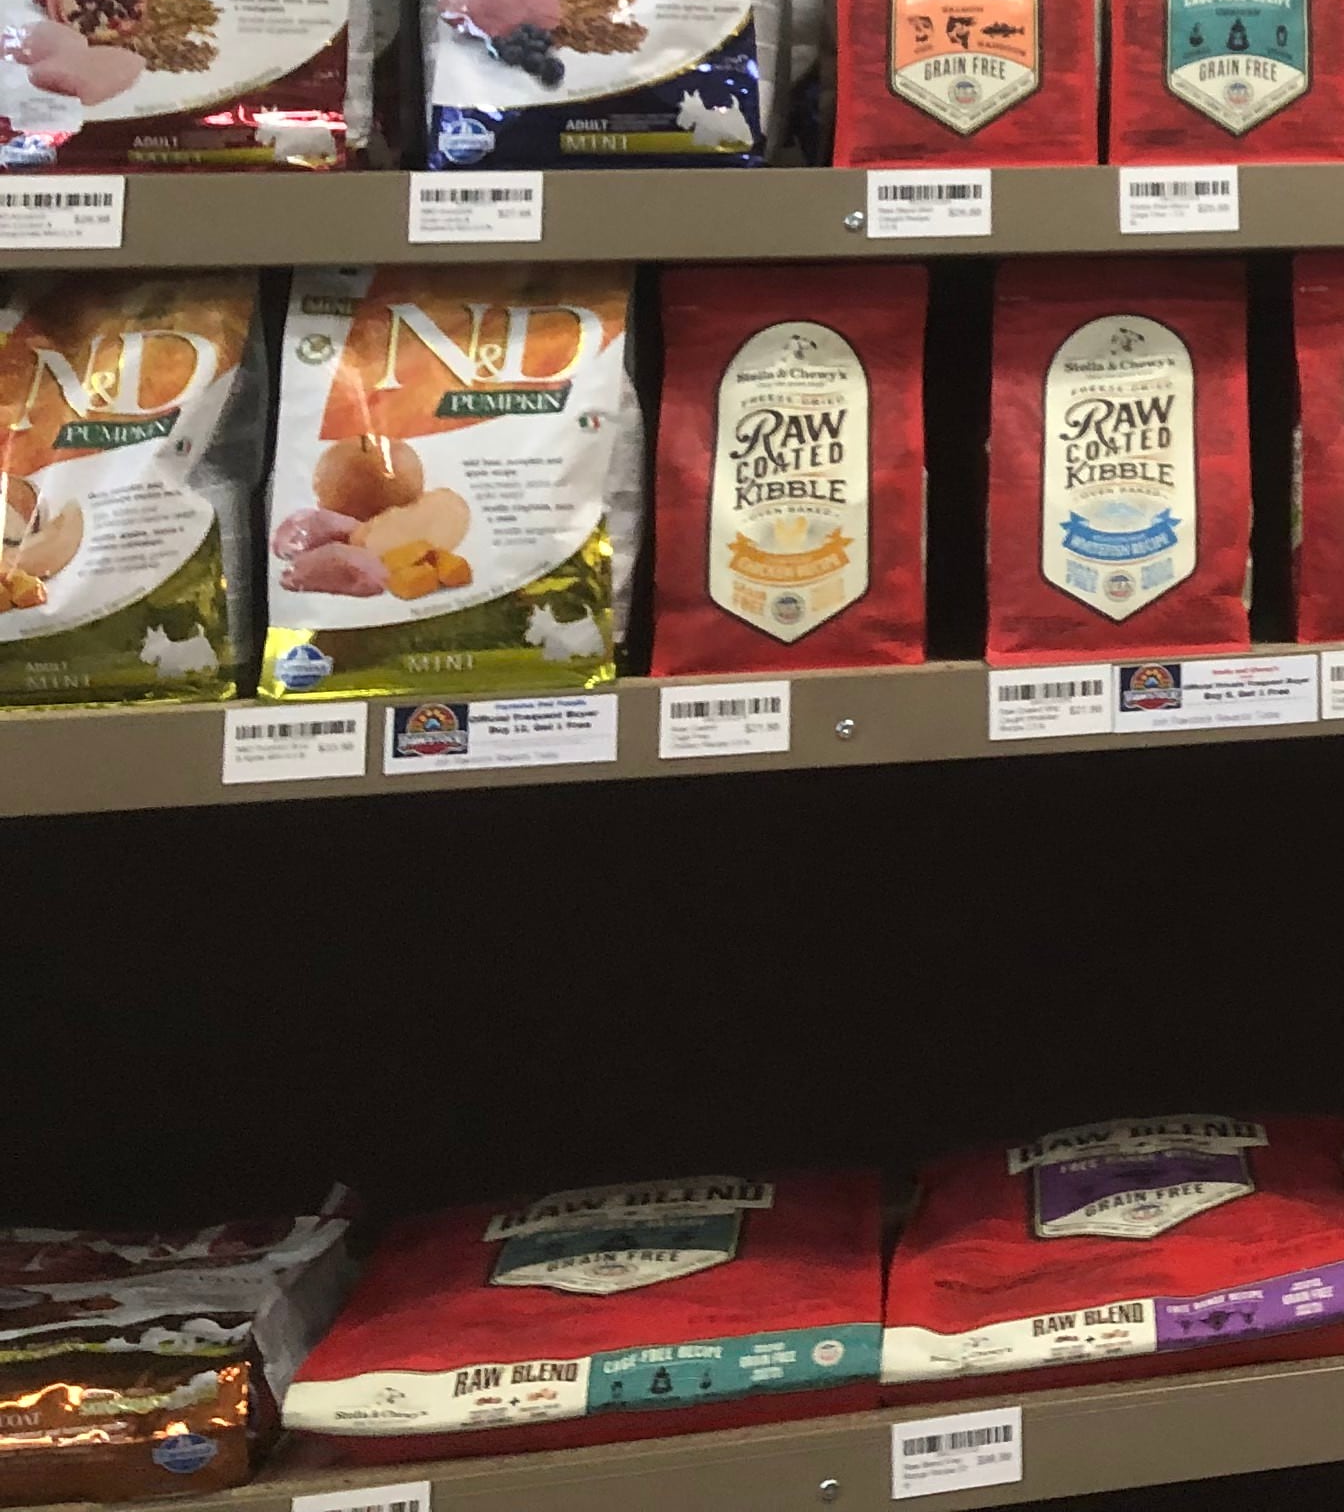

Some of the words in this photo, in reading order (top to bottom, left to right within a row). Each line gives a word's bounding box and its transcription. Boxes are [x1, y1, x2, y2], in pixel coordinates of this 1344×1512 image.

[924, 58, 967, 81] GRAIN
[972, 56, 1006, 80] FREE
[1199, 59, 1240, 82] GRAIN
[1245, 58, 1278, 82] FREE
[565, 118, 609, 131] ADULT
[565, 135, 629, 152] MINI
[375, 302, 604, 391] N&D
[9, 329, 219, 431] N&D
[449, 393, 562, 412] PUMPKIN
[65, 417, 171, 442] PUMPKIN
[1059, 394, 1176, 454] RAW
[729, 408, 849, 467] RAW
[1065, 426, 1172, 464] COATED
[735, 441, 845, 485] COATED
[1063, 460, 1176, 489] KIBBLE
[733, 479, 848, 511] KIBBLE
[406, 653, 475, 673] MINI
[26, 673, 91, 688] MINI
[1203, 691, 1222, 701] Buy
[1267, 688, 1290, 697] Free
[488, 725, 510, 735] Buy
[625, 1184, 766, 1207] BLEND
[1084, 1190, 1147, 1217] GRAIN
[1156, 1183, 1206, 1200] FREE
[547, 1252, 618, 1273] GRAIN
[627, 1249, 681, 1262] FREE
[1031, 1313, 1076, 1337] RAW
[1083, 1302, 1145, 1326] BLEND
[453, 1366, 503, 1397] RAW
[510, 1362, 579, 1385] BLEND
